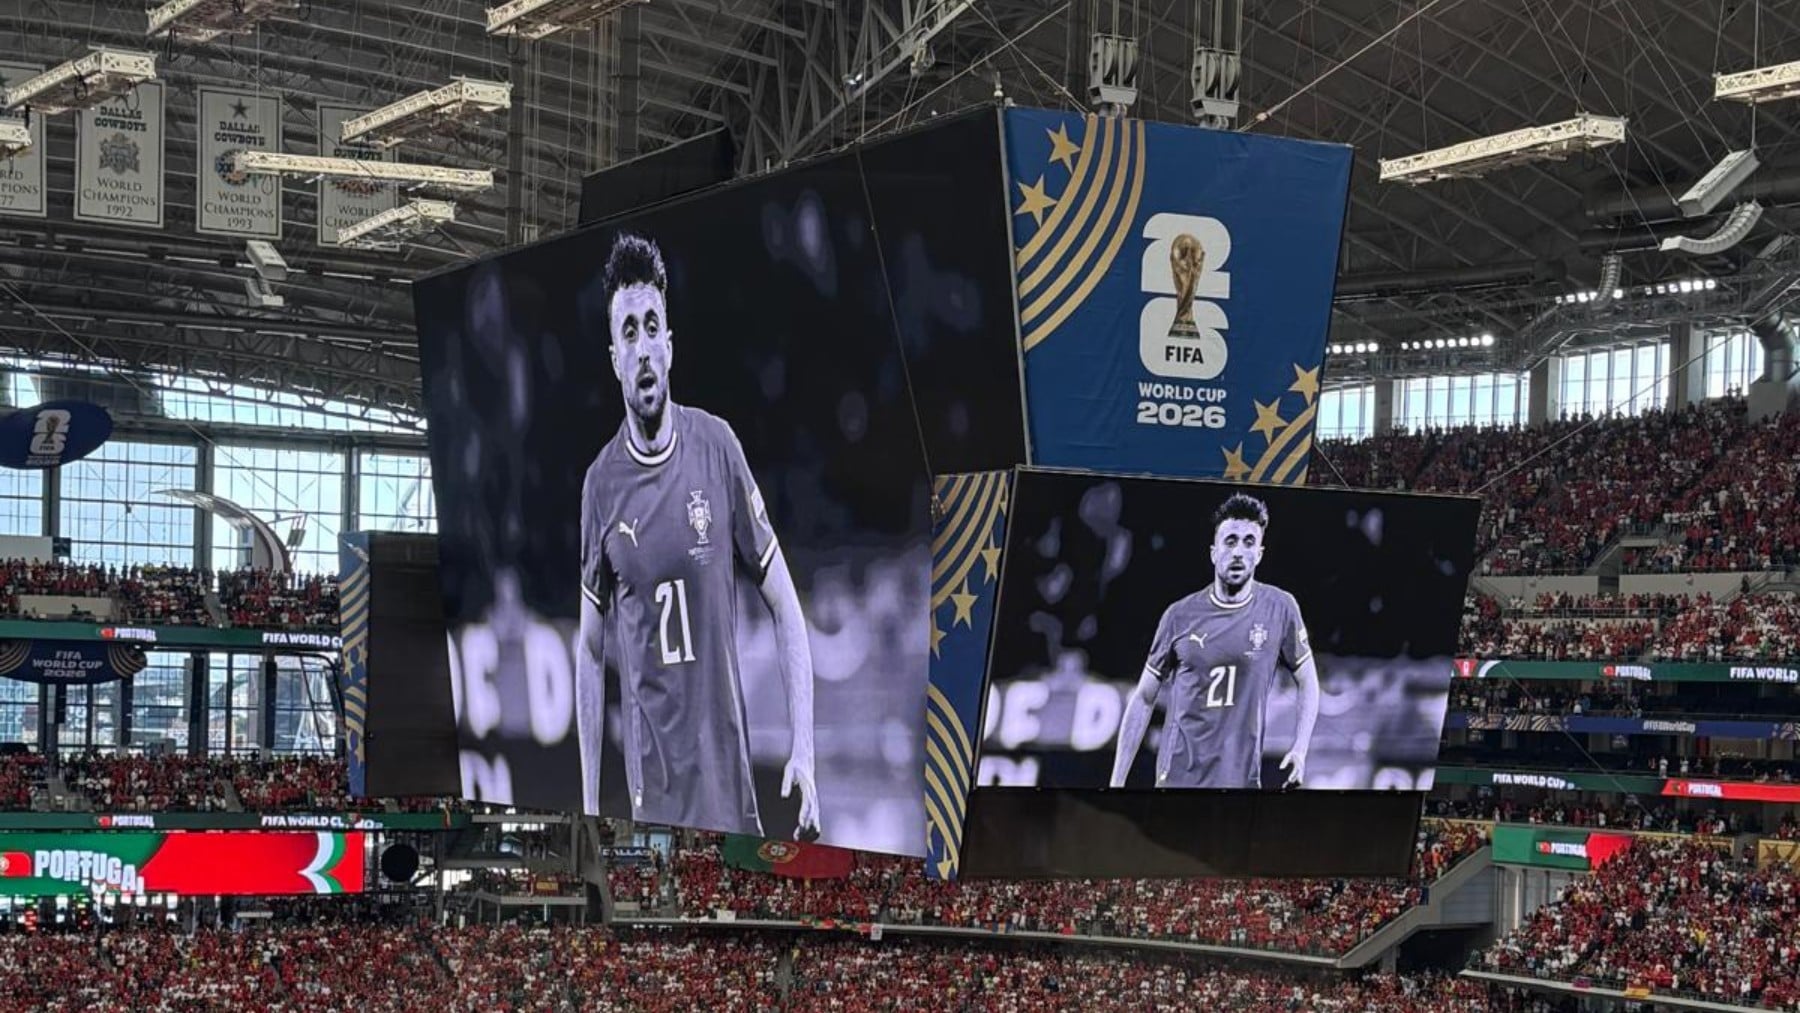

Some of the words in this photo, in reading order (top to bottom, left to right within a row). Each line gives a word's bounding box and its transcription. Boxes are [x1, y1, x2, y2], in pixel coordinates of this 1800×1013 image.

[94, 117, 147, 132] COWBOYS
[219, 121, 261, 134] DALLAS
[214, 132, 265, 146] COWBOYS
[0, 169, 24, 180] RLD
[0, 182, 39, 194] PIONS
[97, 177, 142, 192] WORLD
[0, 195, 15, 206] 77
[83, 188, 156, 206] CHAMPIONS
[217, 191, 262, 204] WORLD
[107, 205, 133, 217] 1992
[204, 204, 275, 219] CHAMPIONS
[227, 219, 252, 229] 1993
[1164, 345, 1204, 364] FIFA
[1138, 382, 1194, 401] WORLD
[1196, 387, 1227, 402] CUP
[1137, 402, 1226, 429] 2026
[655, 578, 696, 664] 21
[262, 633, 287, 643] FIFA
[288, 634, 330, 647] WORLD
[55, 651, 82, 660] FIFA
[32, 659, 77, 669] WORLD
[78, 660, 103, 669] CUP
[1730, 667, 1754, 679] FIFA
[1756, 668, 1799, 682] WORLD
[1206, 665, 1237, 707] 21
[1493, 773, 1512, 784] FIFA
[1513, 775, 1546, 787] WORLD
[1547, 776, 1566, 789] CUP
[112, 815, 155, 828] PORTUGAL
[261, 816, 286, 827] FIFA
[287, 816, 329, 828] WORLD
